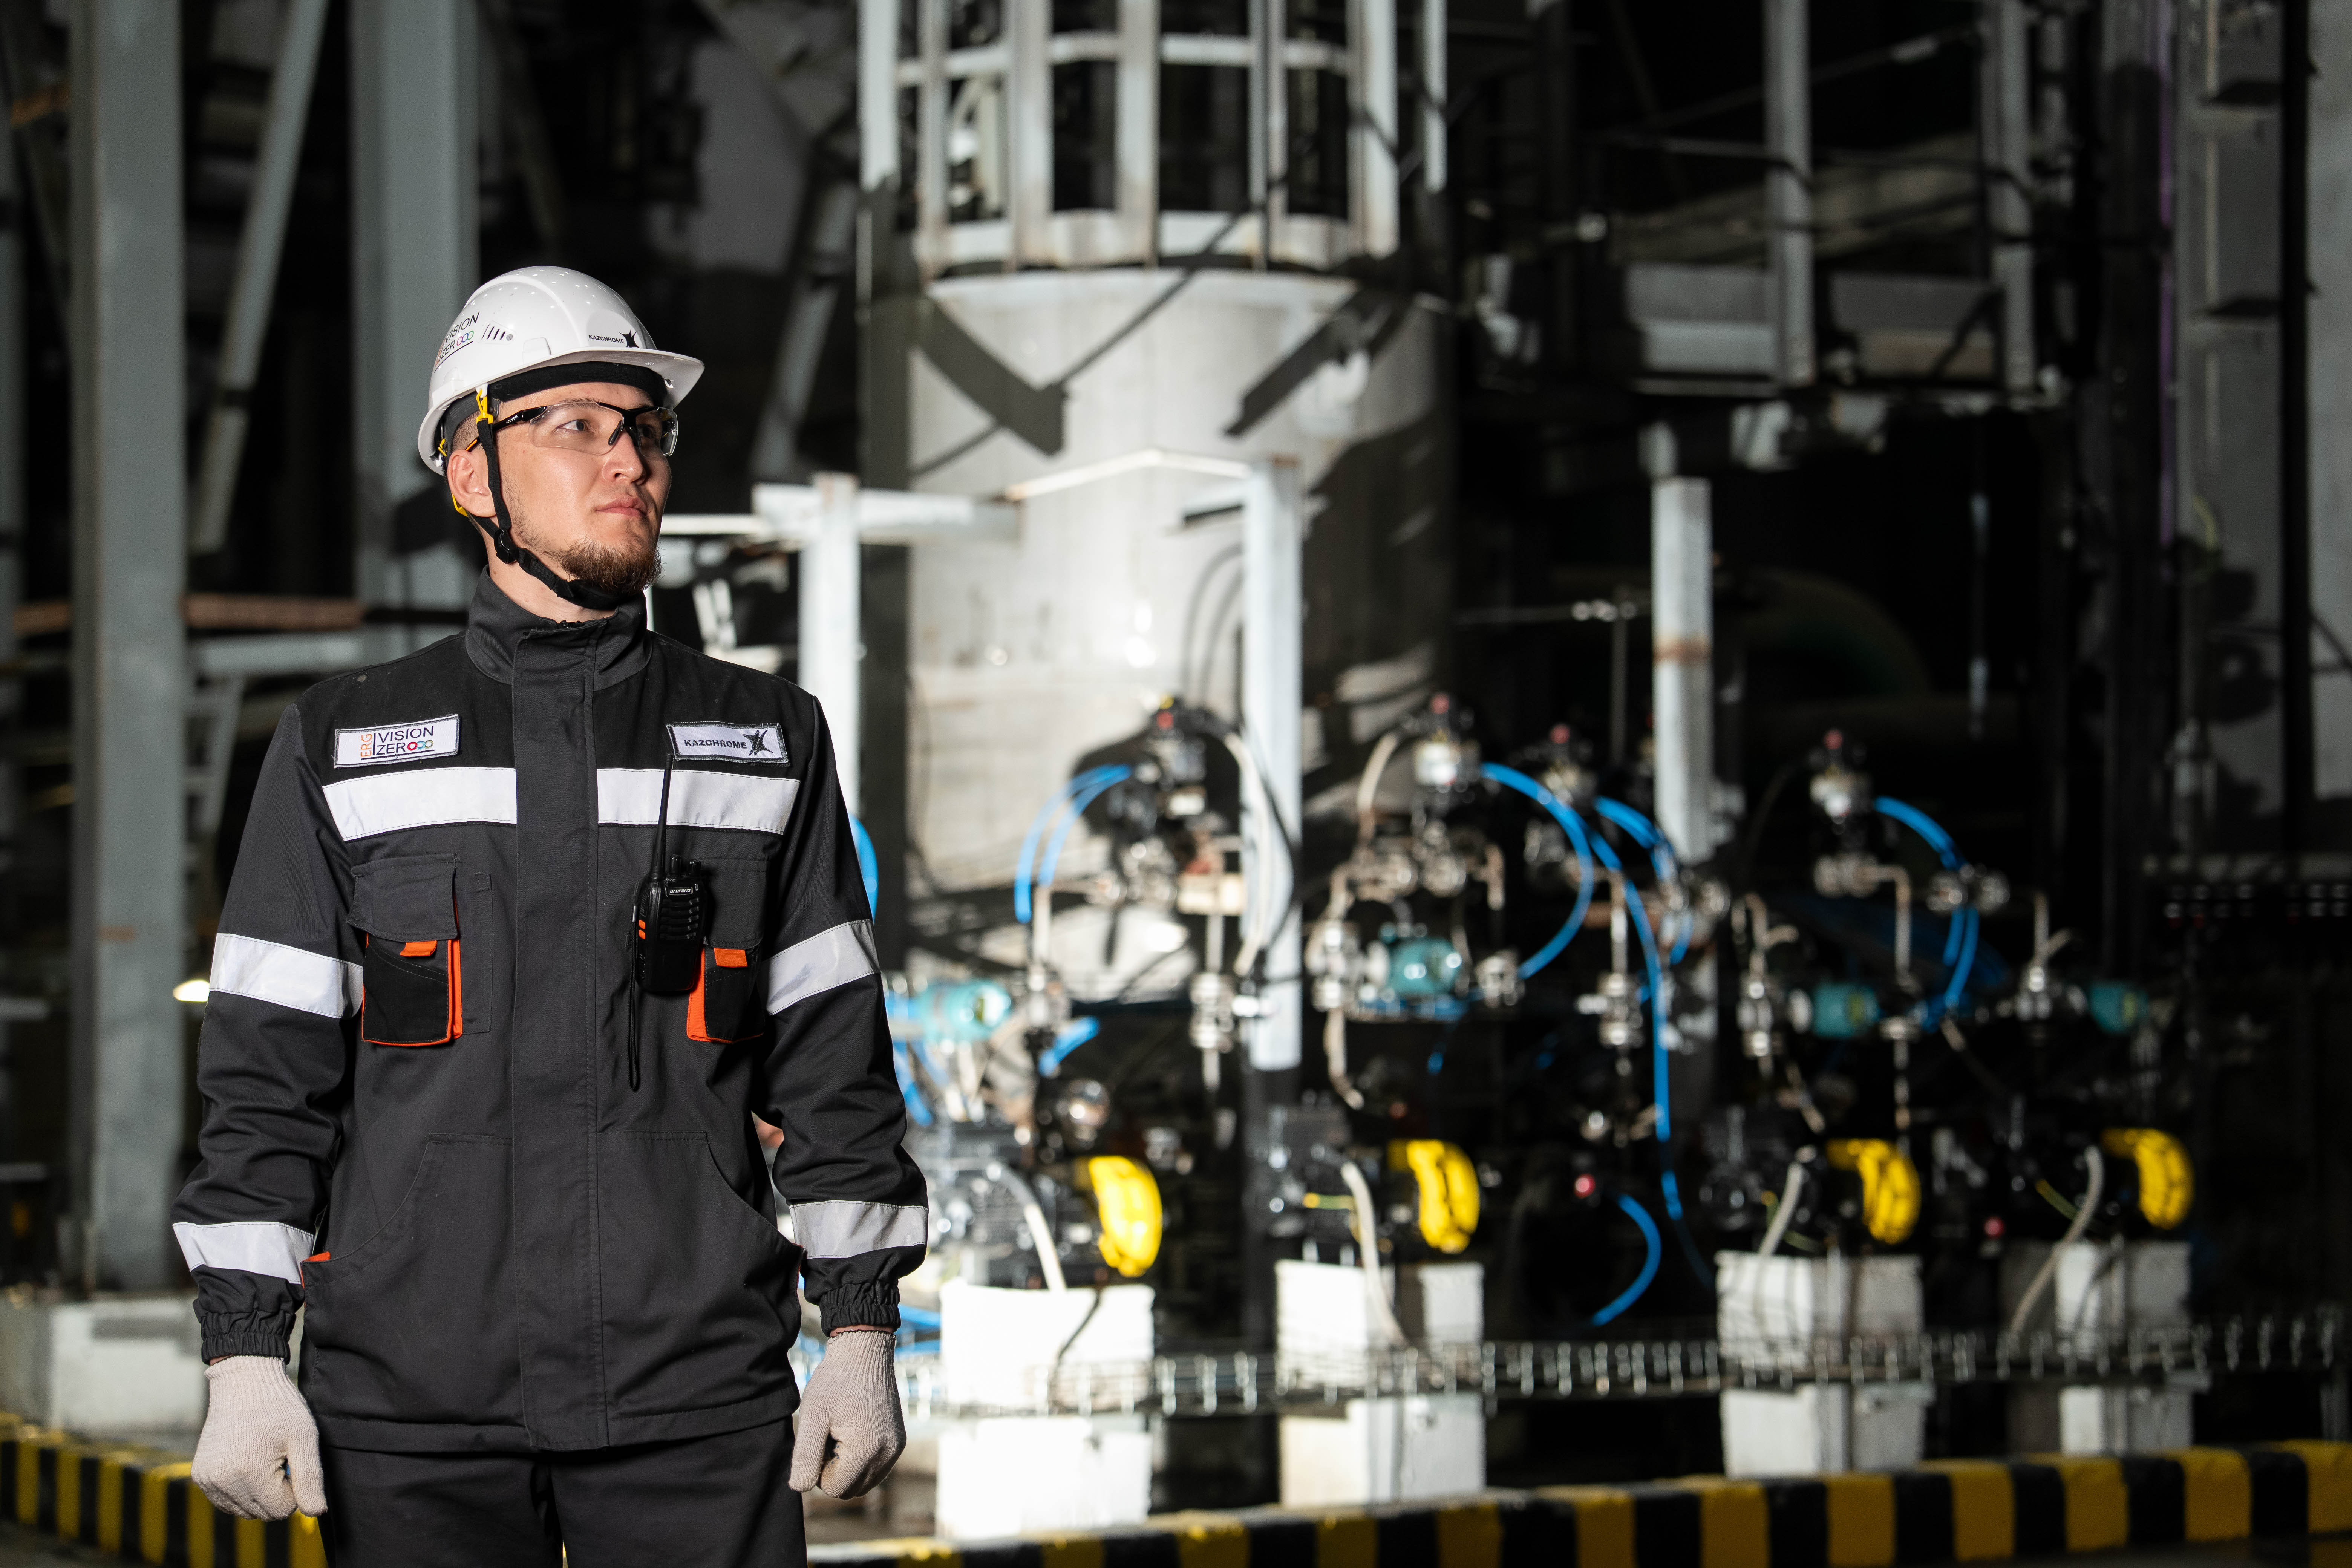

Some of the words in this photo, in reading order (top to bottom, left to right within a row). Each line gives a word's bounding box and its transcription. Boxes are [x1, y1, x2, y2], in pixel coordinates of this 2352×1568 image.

[445, 312, 480, 343] VISION
[588, 335, 625, 343] KAZCHROME
[378, 726, 434, 743] VISION
[360, 733, 372, 757] ERG
